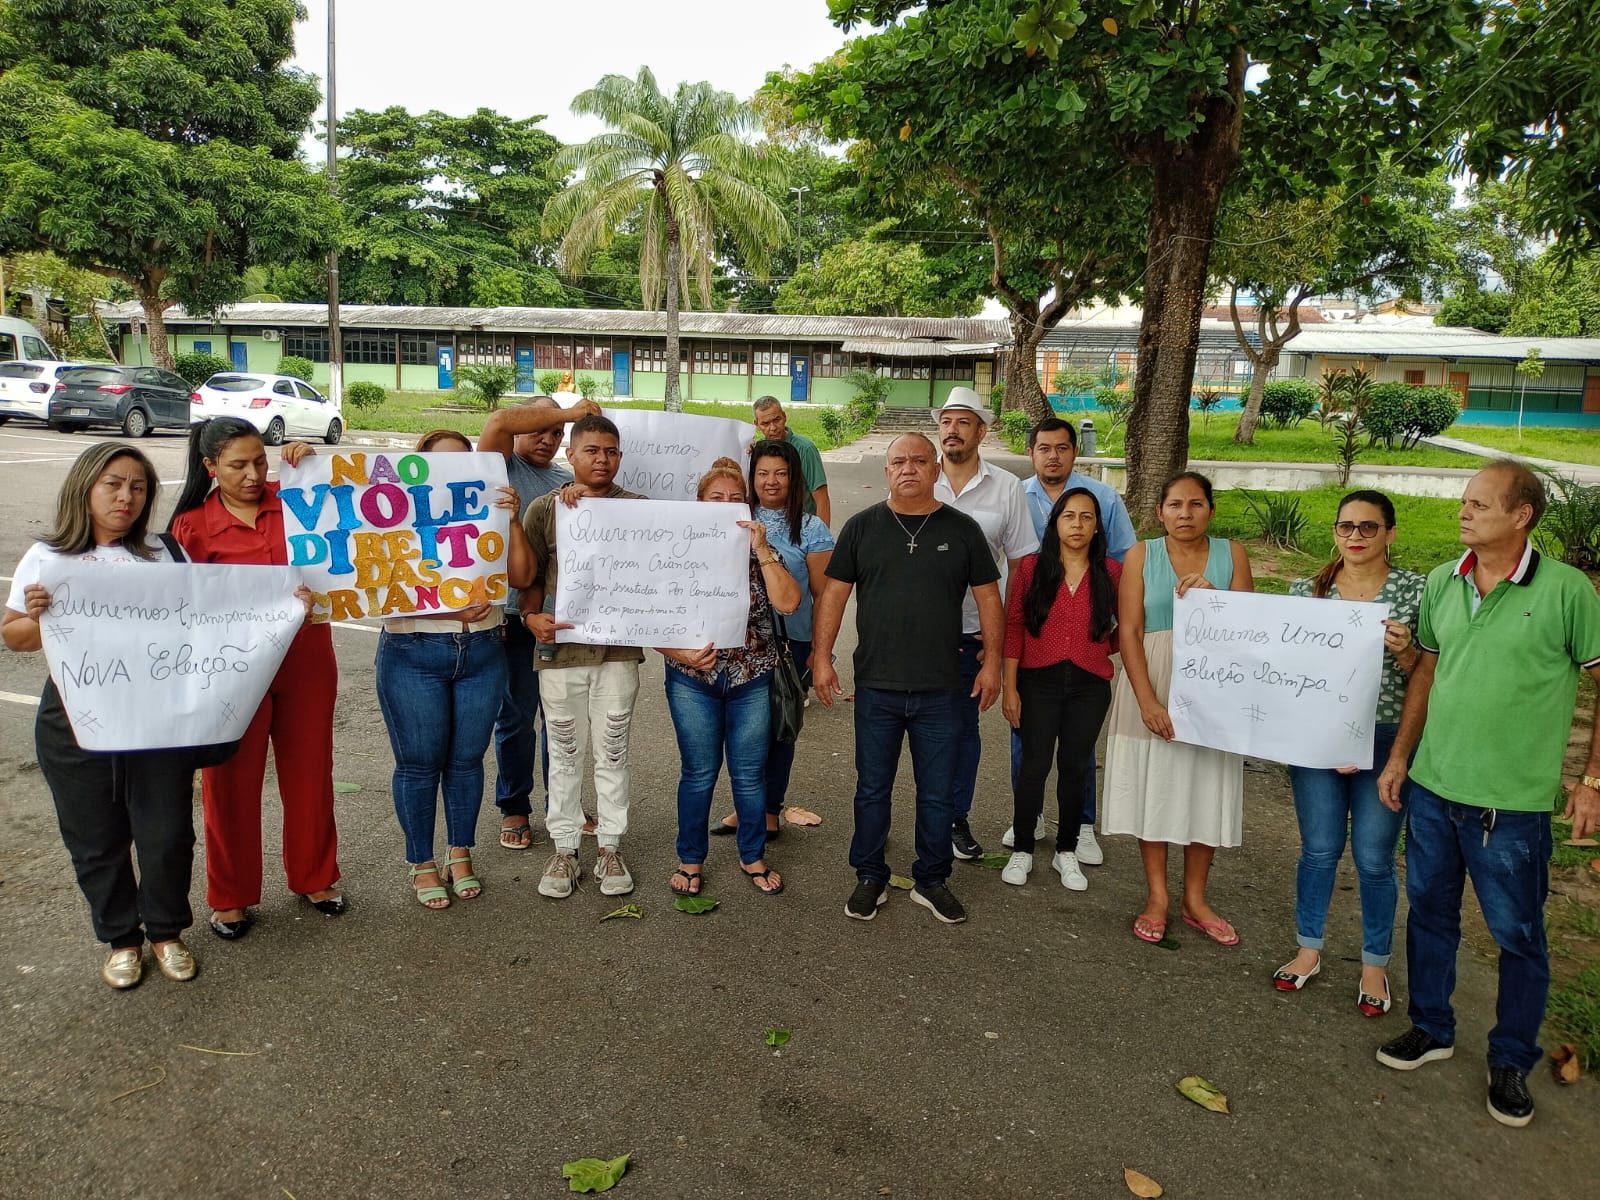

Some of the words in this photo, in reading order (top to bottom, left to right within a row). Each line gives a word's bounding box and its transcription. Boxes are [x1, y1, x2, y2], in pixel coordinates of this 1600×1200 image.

[276, 480, 490, 532] VIOLE
[569, 509, 674, 543] Queremos
[288, 523, 505, 575] DIREITO
[564, 549, 594, 574] Que
[648, 552, 709, 578] Crianças
[353, 557, 443, 590] DAS
[47, 582, 171, 621] Queremos
[174, 596, 296, 635] transparência
[1184, 607, 1270, 646] Queremos
[582, 621, 602, 635] NÃO
[609, 624, 618, 635] A
[605, 637, 637, 645] DIREITO
[61, 650, 132, 701] NOVA
[147, 642, 258, 690] Eleição
